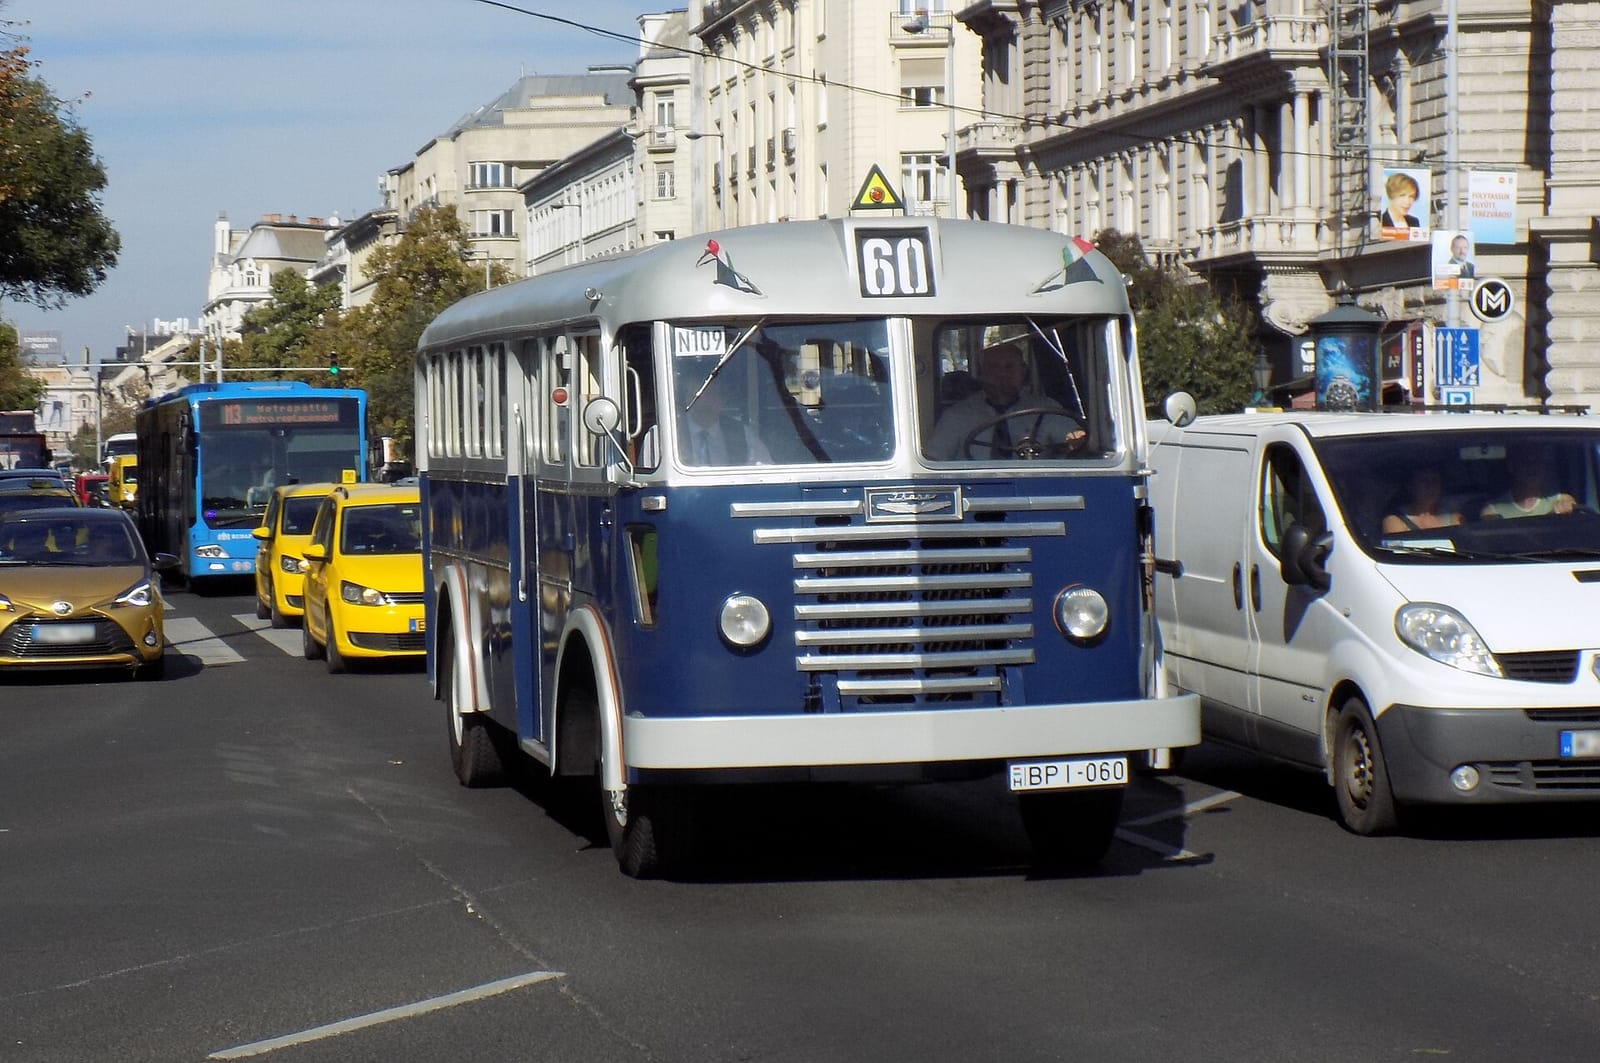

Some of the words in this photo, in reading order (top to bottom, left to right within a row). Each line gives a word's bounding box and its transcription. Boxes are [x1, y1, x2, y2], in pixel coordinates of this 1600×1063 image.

[862, 238, 929, 295] 60
[1481, 286, 1507, 312] M
[678, 328, 722, 353] N109
[1029, 761, 1124, 786] BPI-060
